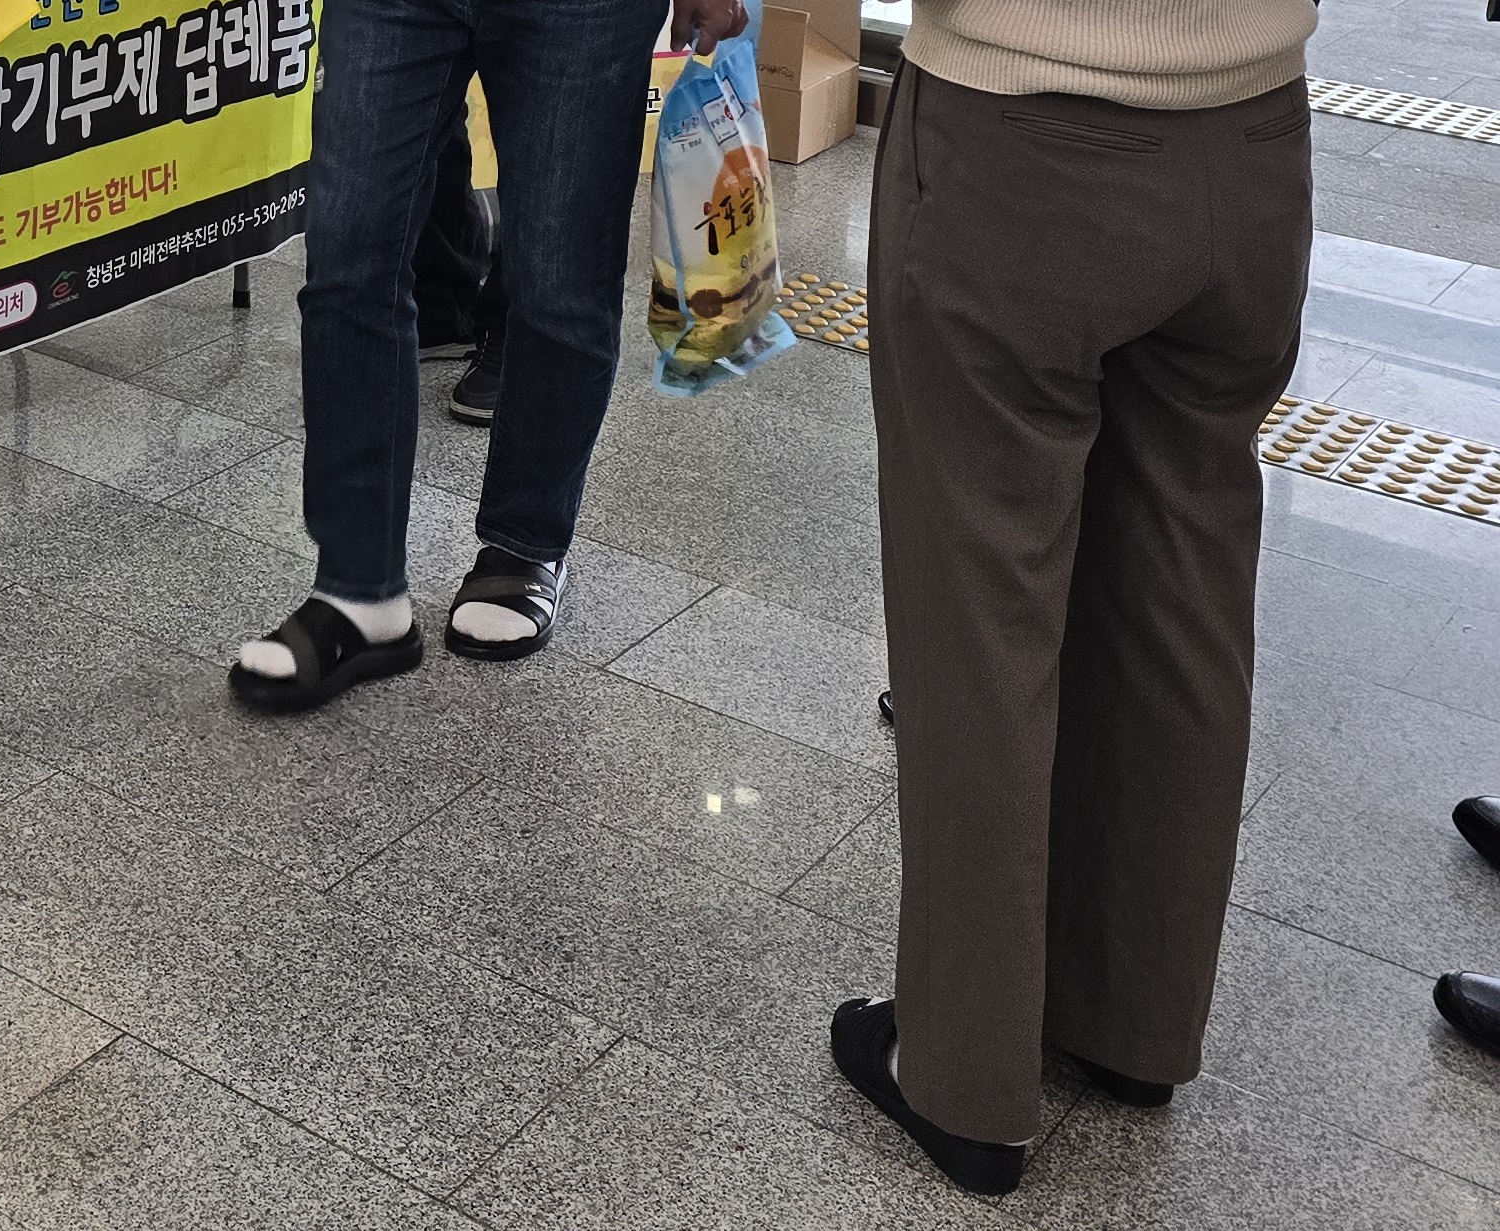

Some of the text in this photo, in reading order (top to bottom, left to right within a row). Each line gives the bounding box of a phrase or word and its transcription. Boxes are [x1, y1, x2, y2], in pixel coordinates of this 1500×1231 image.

[15, 160, 179, 240] 기부가능합니다!
[86, 254, 127, 289] 창녕군
[130, 221, 219, 270] 미래전략추진단
